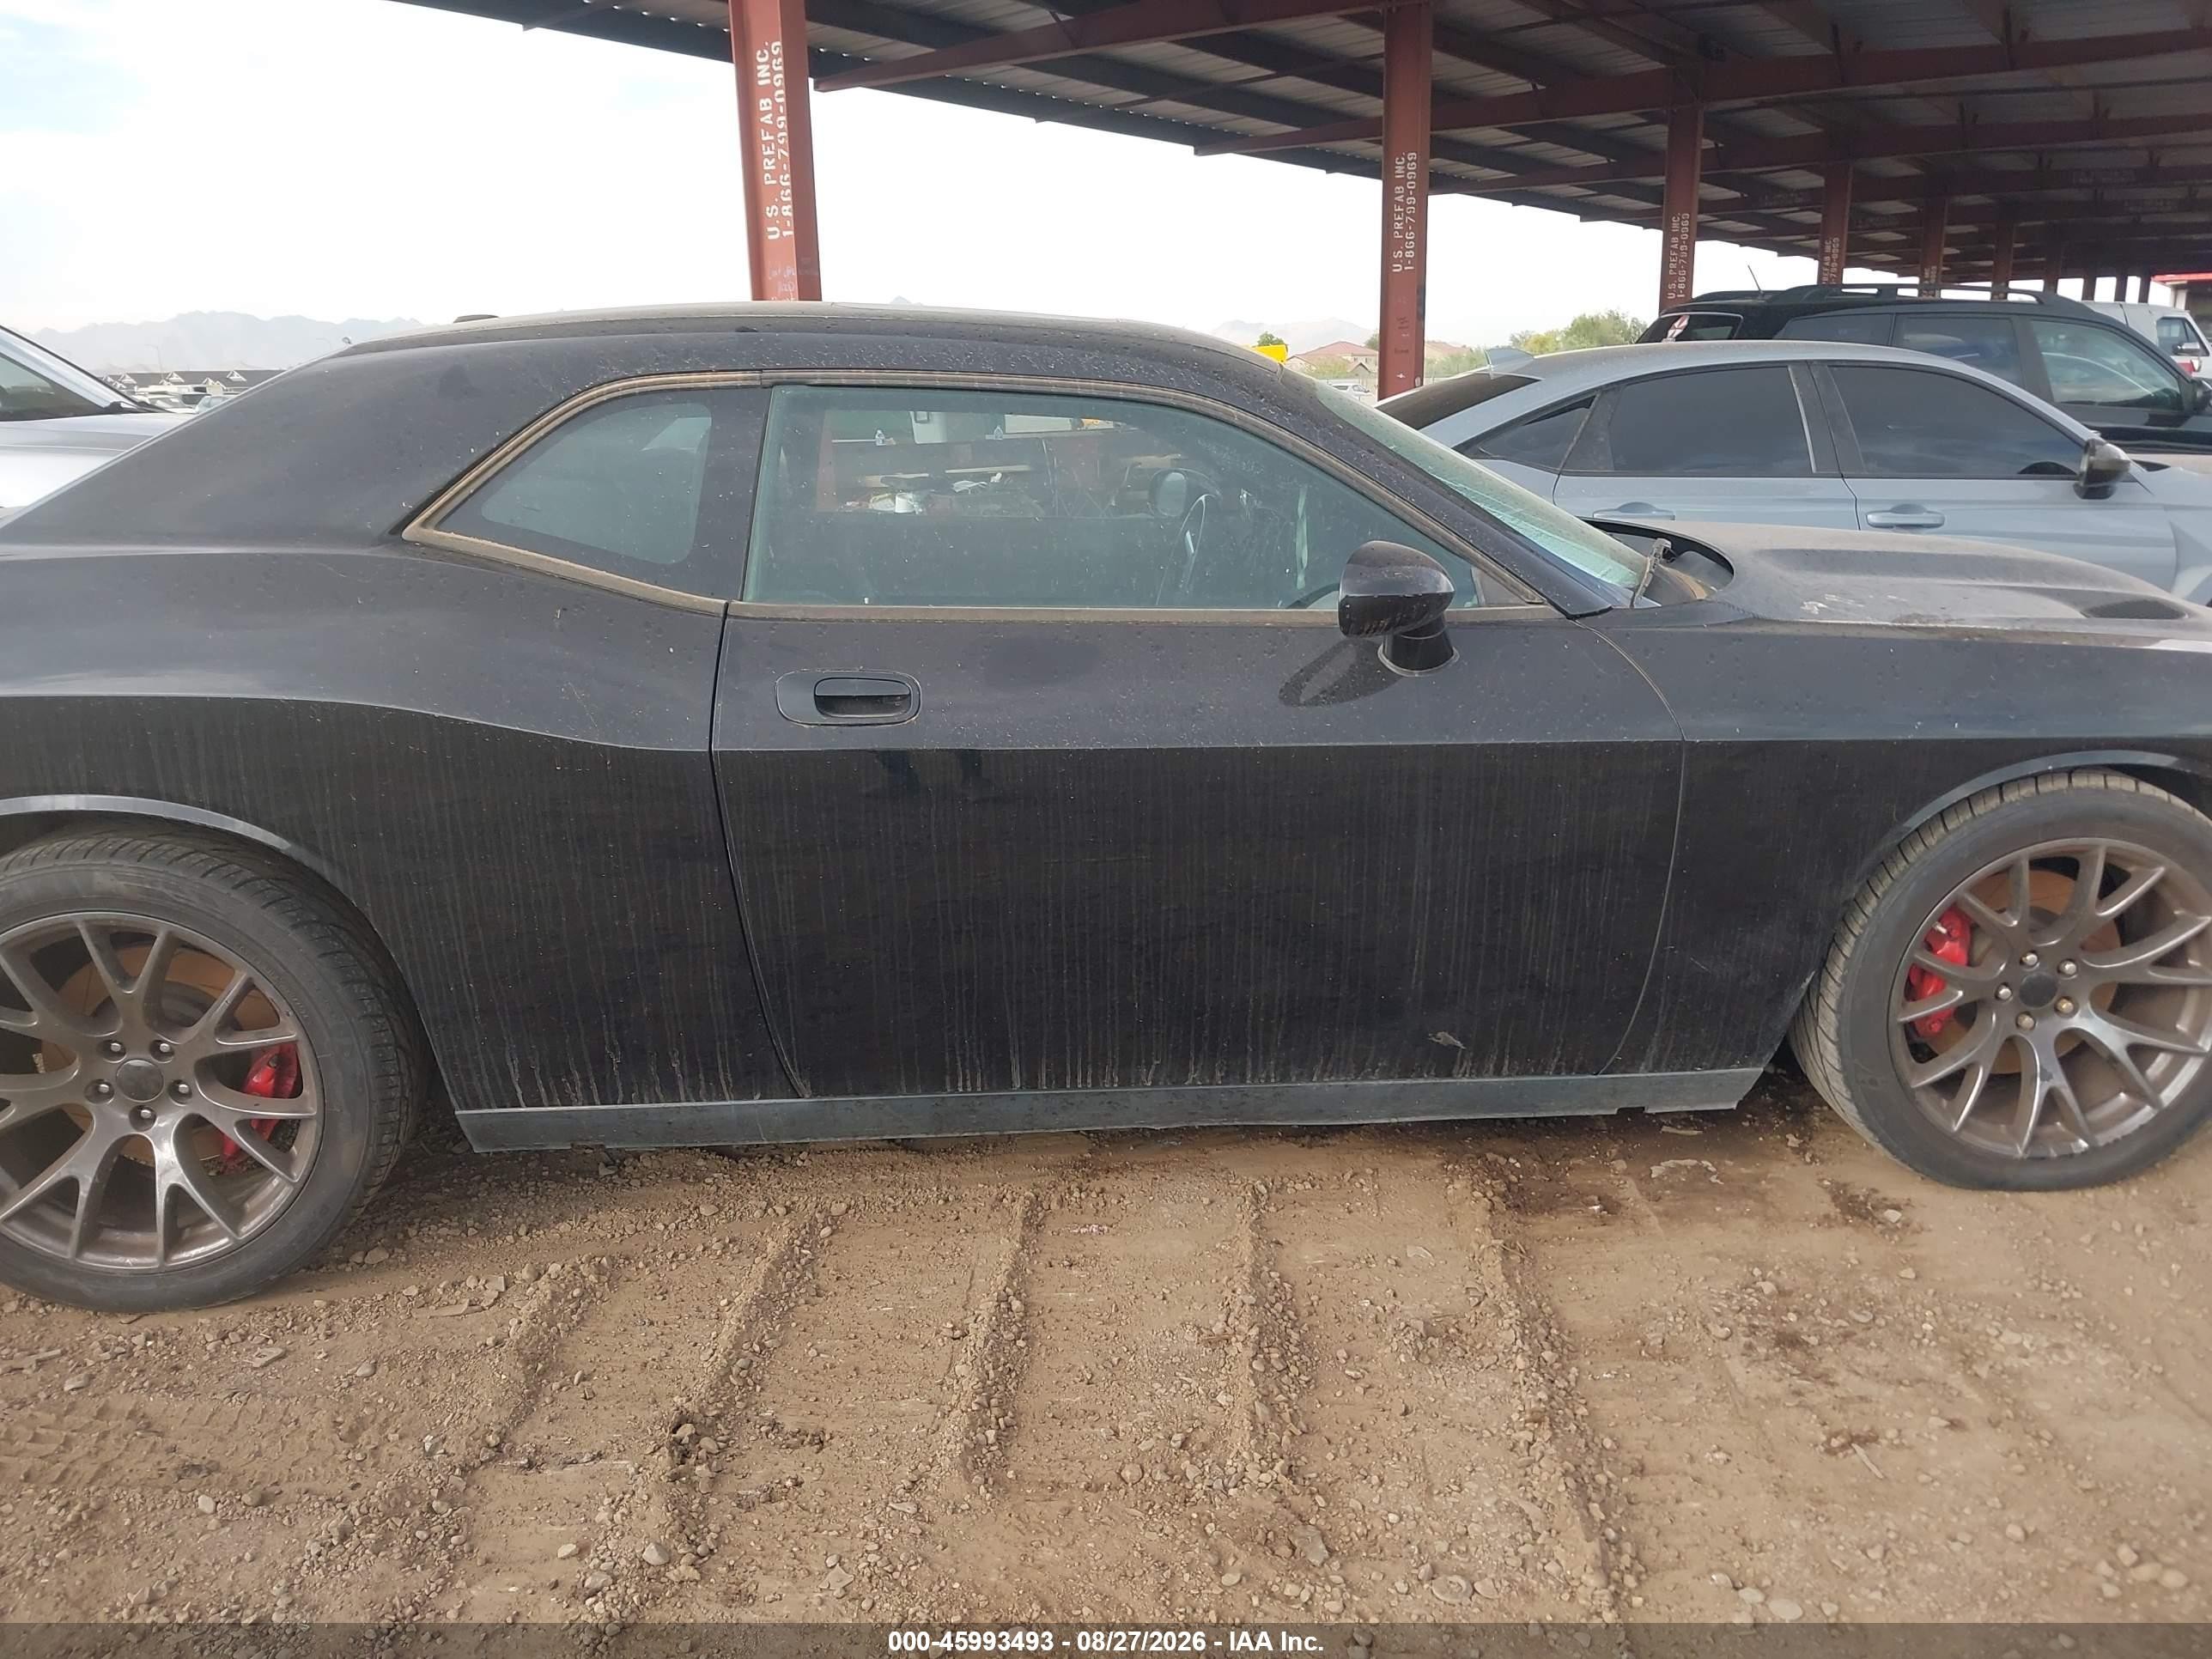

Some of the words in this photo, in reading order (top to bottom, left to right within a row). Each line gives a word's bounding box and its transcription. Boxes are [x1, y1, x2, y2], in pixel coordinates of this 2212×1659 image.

[757, 41, 770, 87] INC.
[759, 97, 777, 185] PREFAB
[1395, 152, 1406, 179] INC.
[766, 198, 781, 240] U.S.
[1393, 185, 1404, 239] PREFAB
[1392, 246, 1403, 272] U.S.
[1668, 237, 1679, 276] PREFAB
